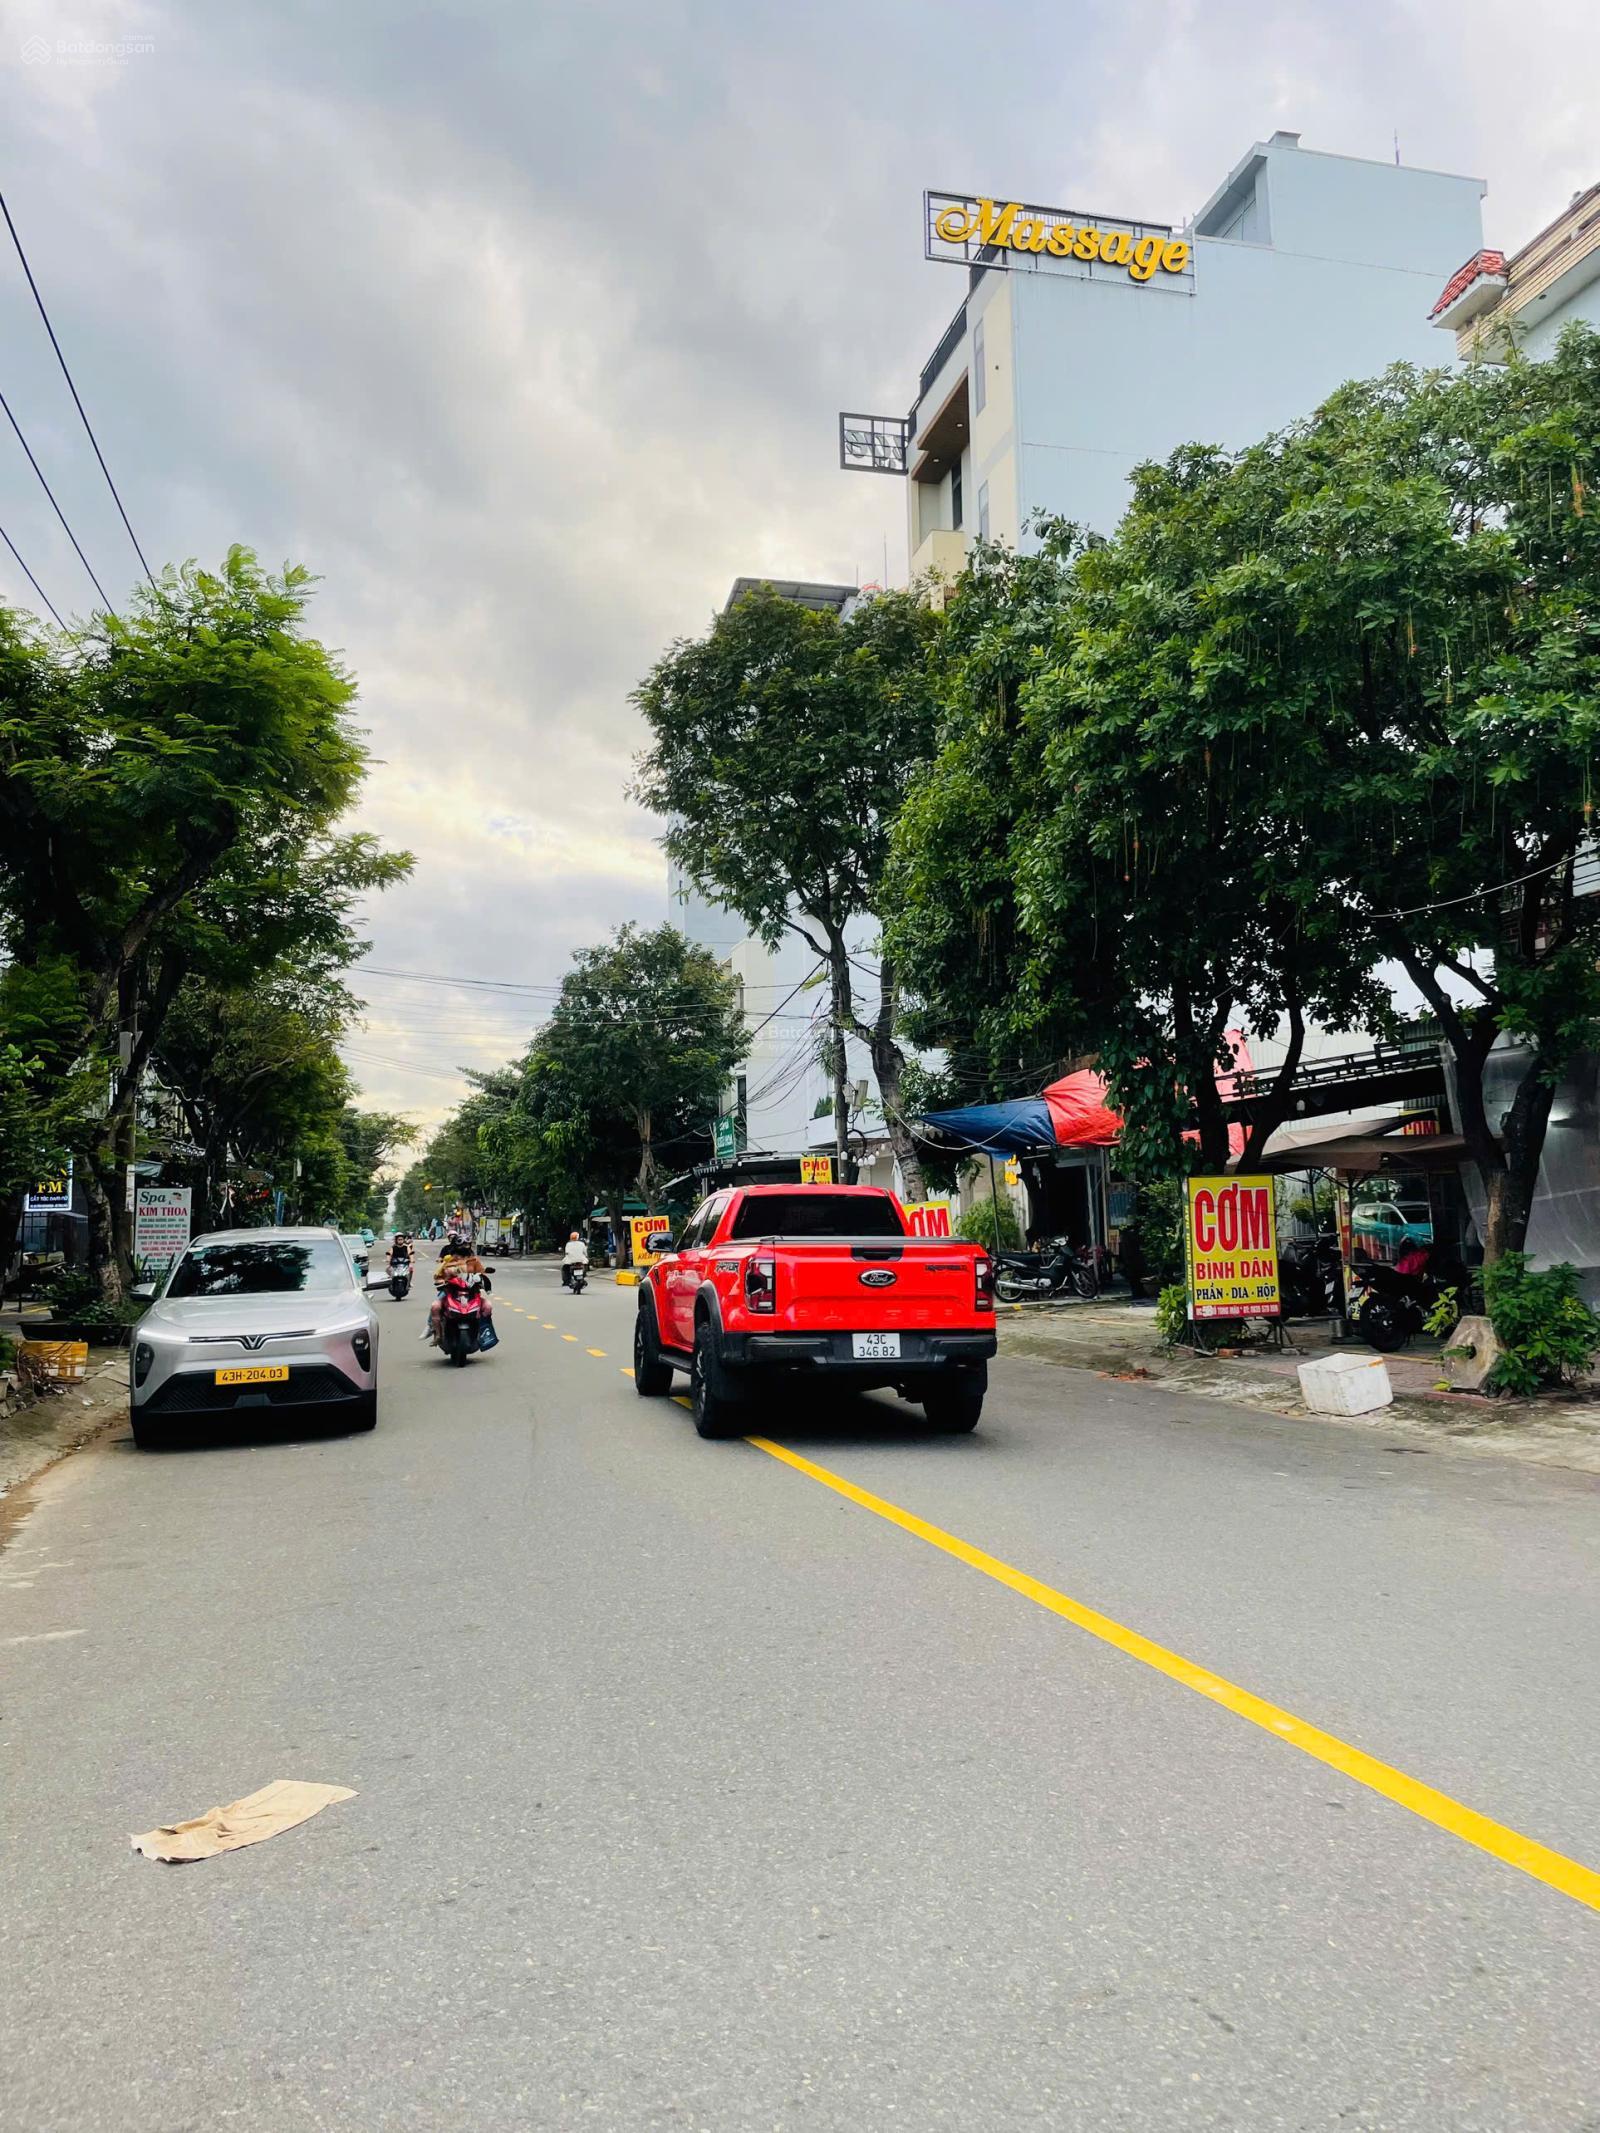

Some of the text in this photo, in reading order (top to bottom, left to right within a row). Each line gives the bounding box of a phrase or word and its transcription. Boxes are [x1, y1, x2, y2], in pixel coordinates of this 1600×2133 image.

[935, 198, 1190, 282] Massage
[139, 1191, 166, 1205] Spa
[138, 1206, 188, 1217] KIM THOA
[1194, 1182, 1271, 1253] CƠM
[634, 1219, 667, 1233] CƠM
[909, 1206, 950, 1237] ƠM
[1195, 1257, 1274, 1280] BÌNH DÂN
[1256, 1282, 1276, 1301] HỘP
[866, 1334, 887, 1345] 43C
[859, 1346, 895, 1357] 346.82
[222, 1368, 283, 1382] 43H-204.03
